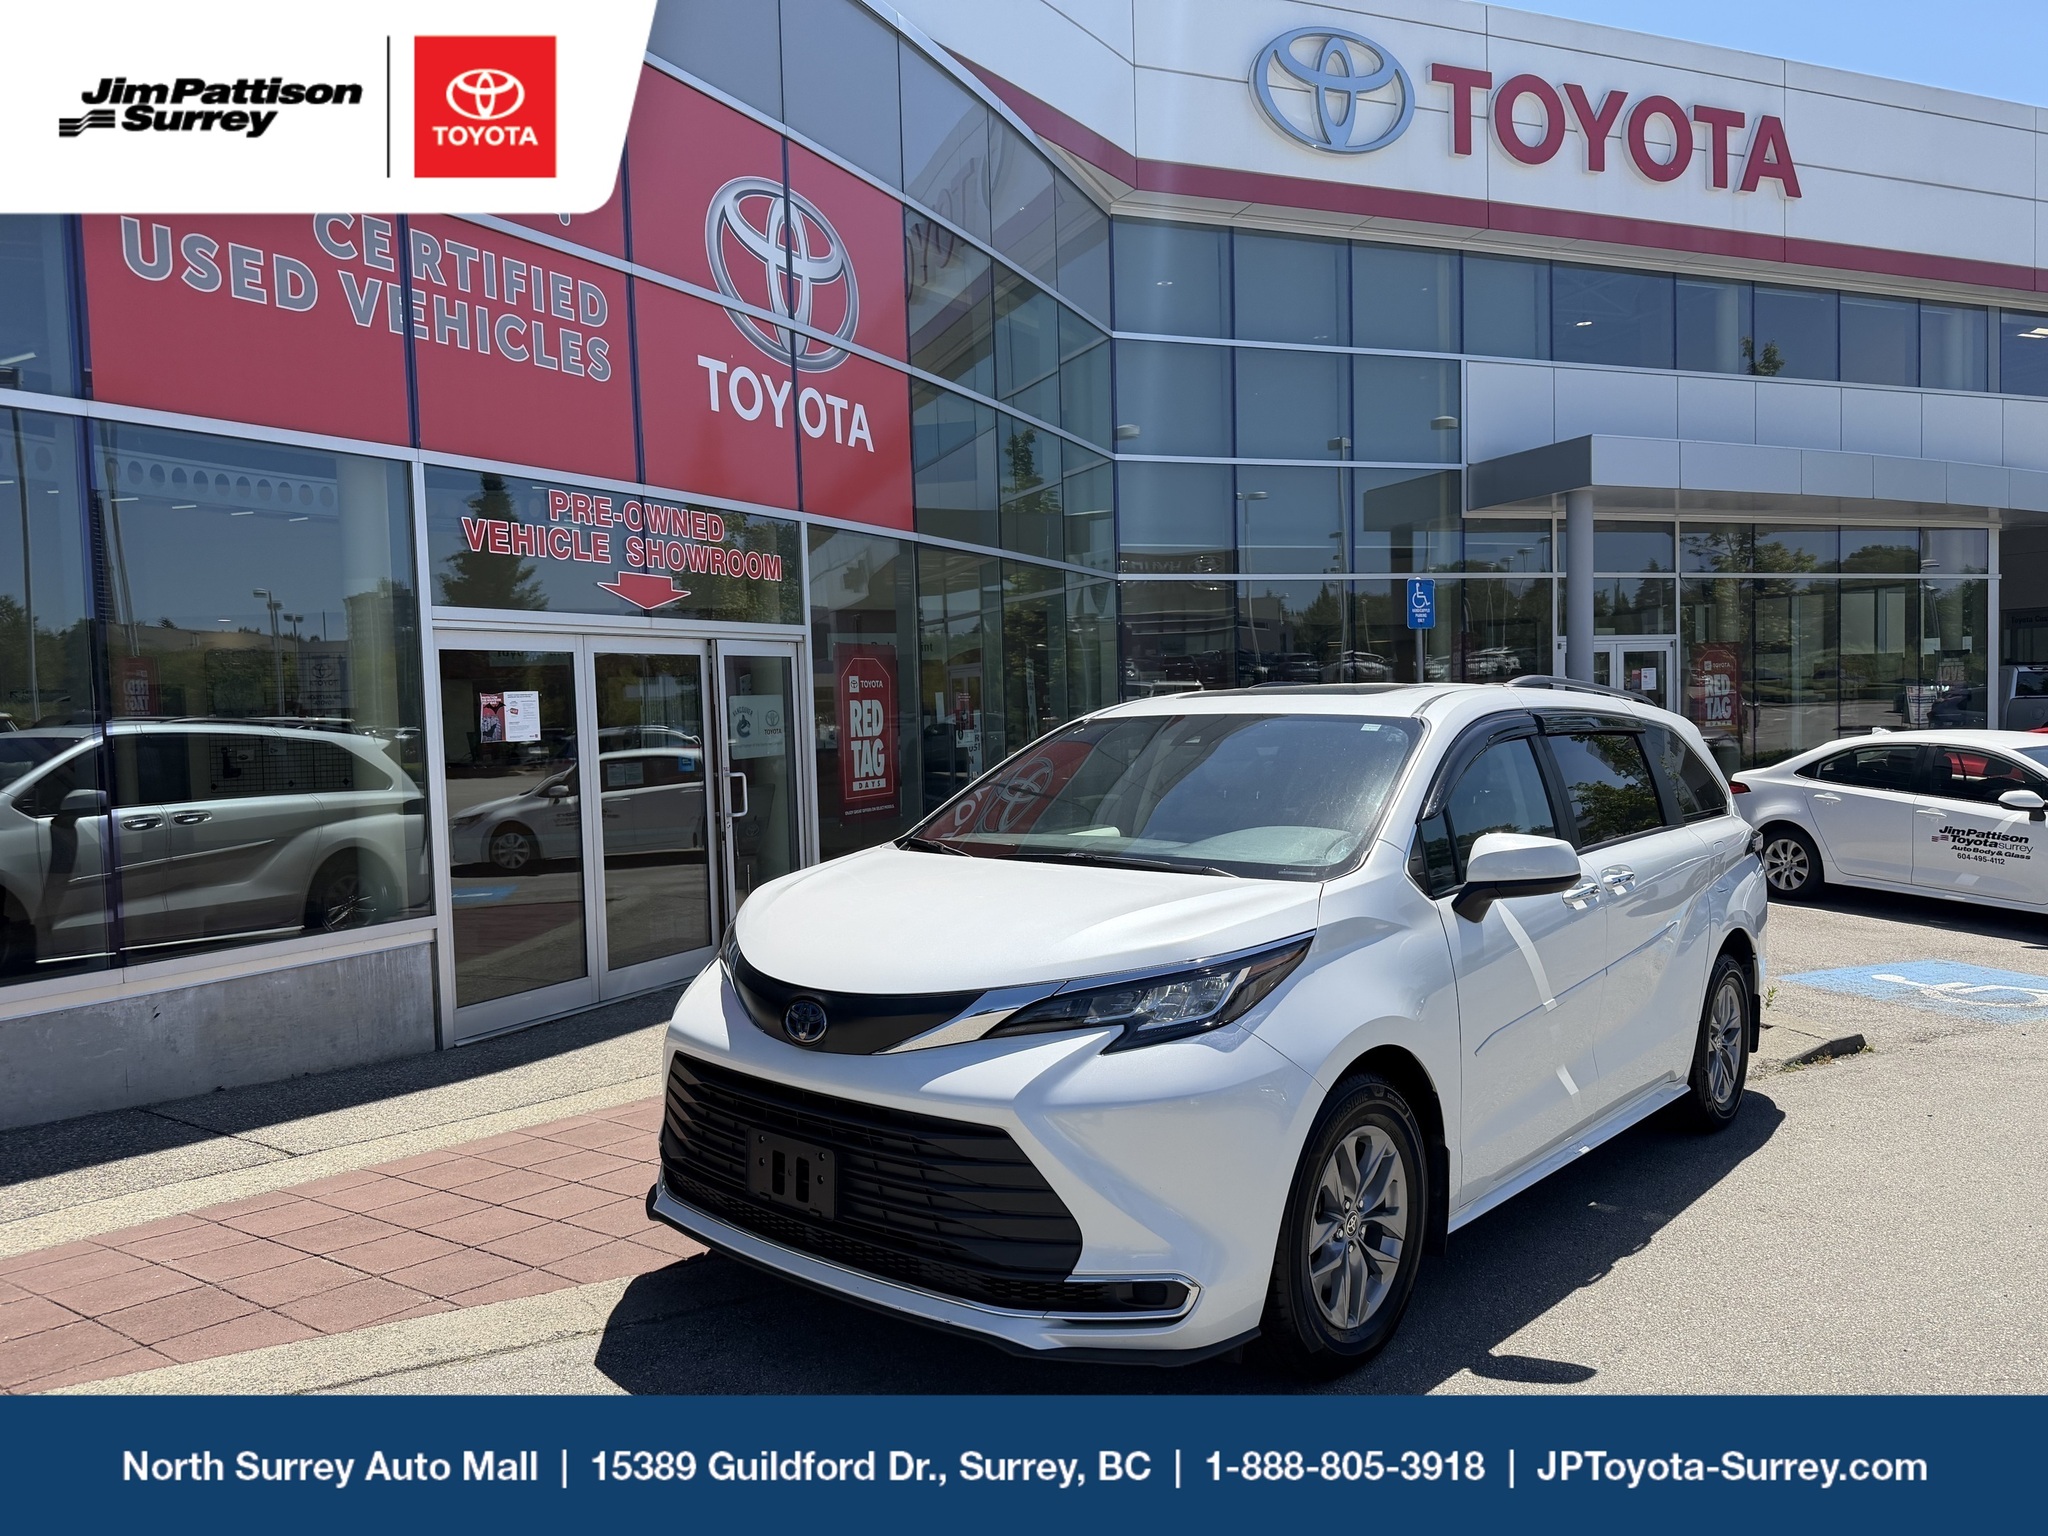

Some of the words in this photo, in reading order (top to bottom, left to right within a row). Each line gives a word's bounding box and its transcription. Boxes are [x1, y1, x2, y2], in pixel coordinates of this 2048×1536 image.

[1427, 62, 1803, 200] TOYOTA
[313, 213, 609, 328] CERTIFIED
[120, 215, 319, 312] USED
[338, 269, 612, 382] VEHICLES
[697, 354, 875, 453] TOYOTA
[548, 489, 725, 542] PRE-OWNED
[461, 517, 612, 564] VEHICLE
[626, 536, 783, 582] SHOWROOM
[860, 680, 884, 688] TOYOTA
[1705, 674, 1731, 696] RED
[849, 700, 884, 737] RED
[1705, 697, 1731, 719] TAG
[851, 739, 885, 778] TAG
[1957, 853, 2005, 865] 604-495-4112
[1973, 847, 1996, 856] Body
[2004, 852, 2031, 860] Glass
